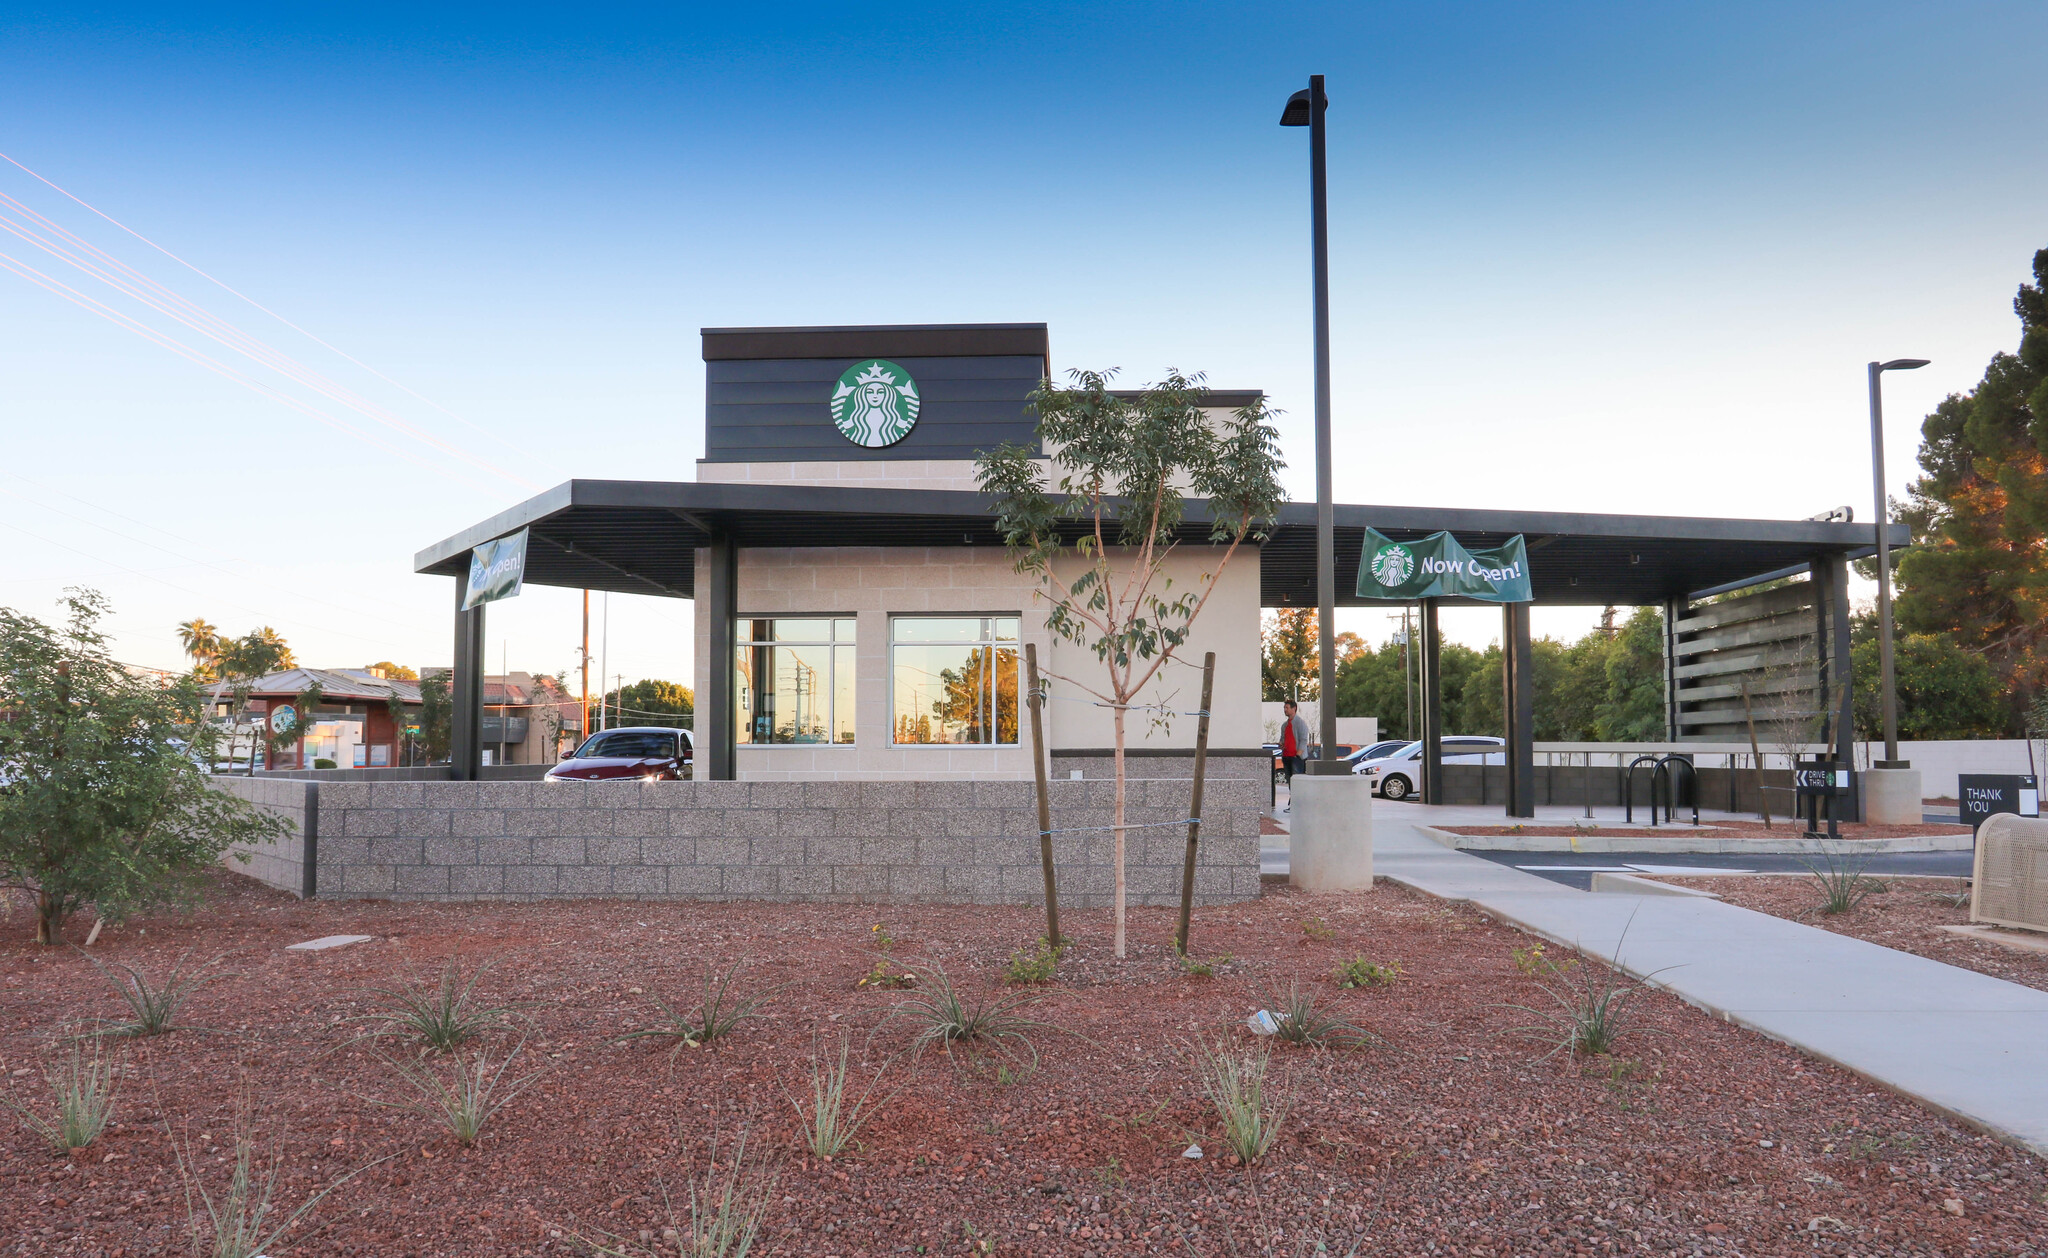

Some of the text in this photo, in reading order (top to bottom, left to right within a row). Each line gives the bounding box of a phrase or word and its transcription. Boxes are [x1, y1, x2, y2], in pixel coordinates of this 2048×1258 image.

[1421, 556, 1522, 581] Now Open!
[1808, 770, 1826, 779] DRIVE
[1809, 779, 1825, 787] THRU
[1966, 788, 2003, 801] THANK
[1967, 801, 1989, 813] YOU
